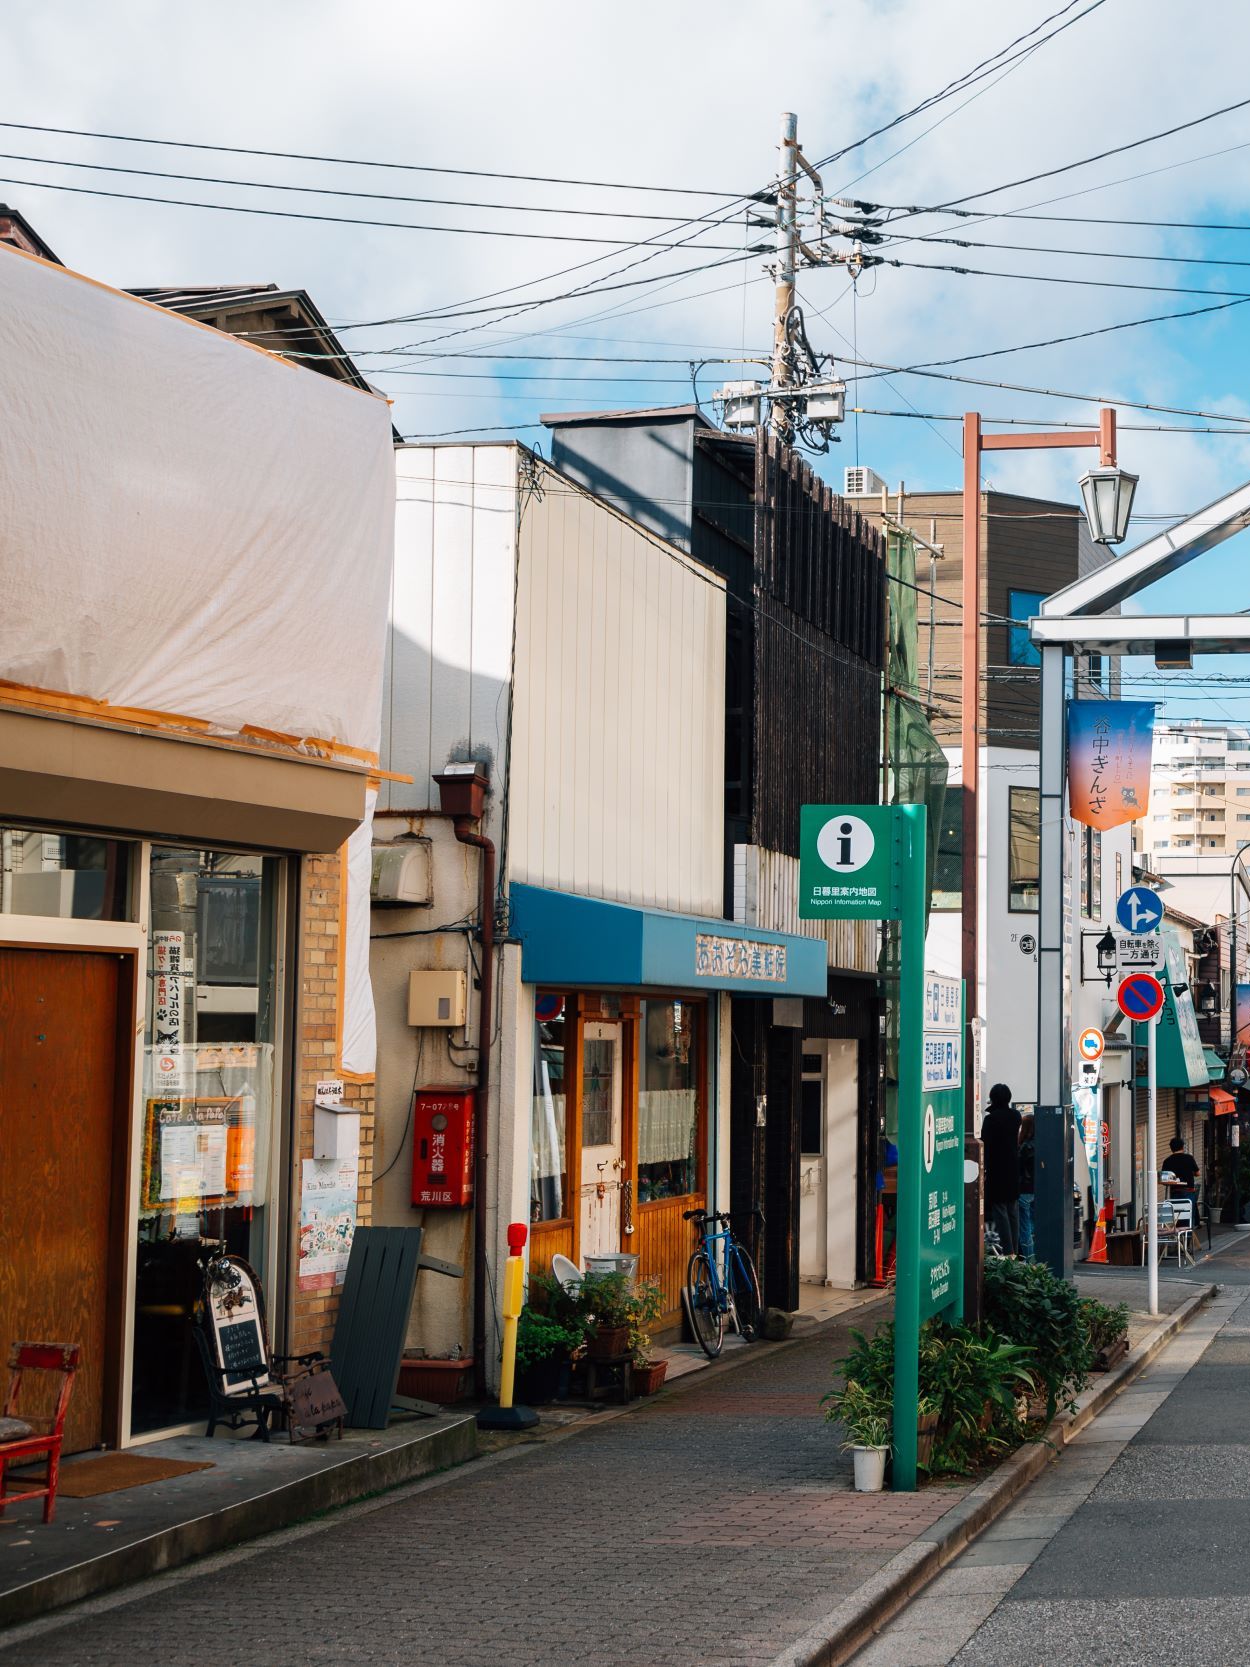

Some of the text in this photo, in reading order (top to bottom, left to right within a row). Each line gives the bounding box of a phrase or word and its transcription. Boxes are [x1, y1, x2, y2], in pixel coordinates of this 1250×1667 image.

[1089, 715, 1112, 815] 谷中ぎんざ
[813, 887, 877, 897] 日暮里案内地図
[1119, 940, 1160, 949] 自転車を除く
[1119, 950, 1160, 959] 一方通行
[431, 1134, 446, 1171] 消火器
[421, 1191, 452, 1201] 荒川区
